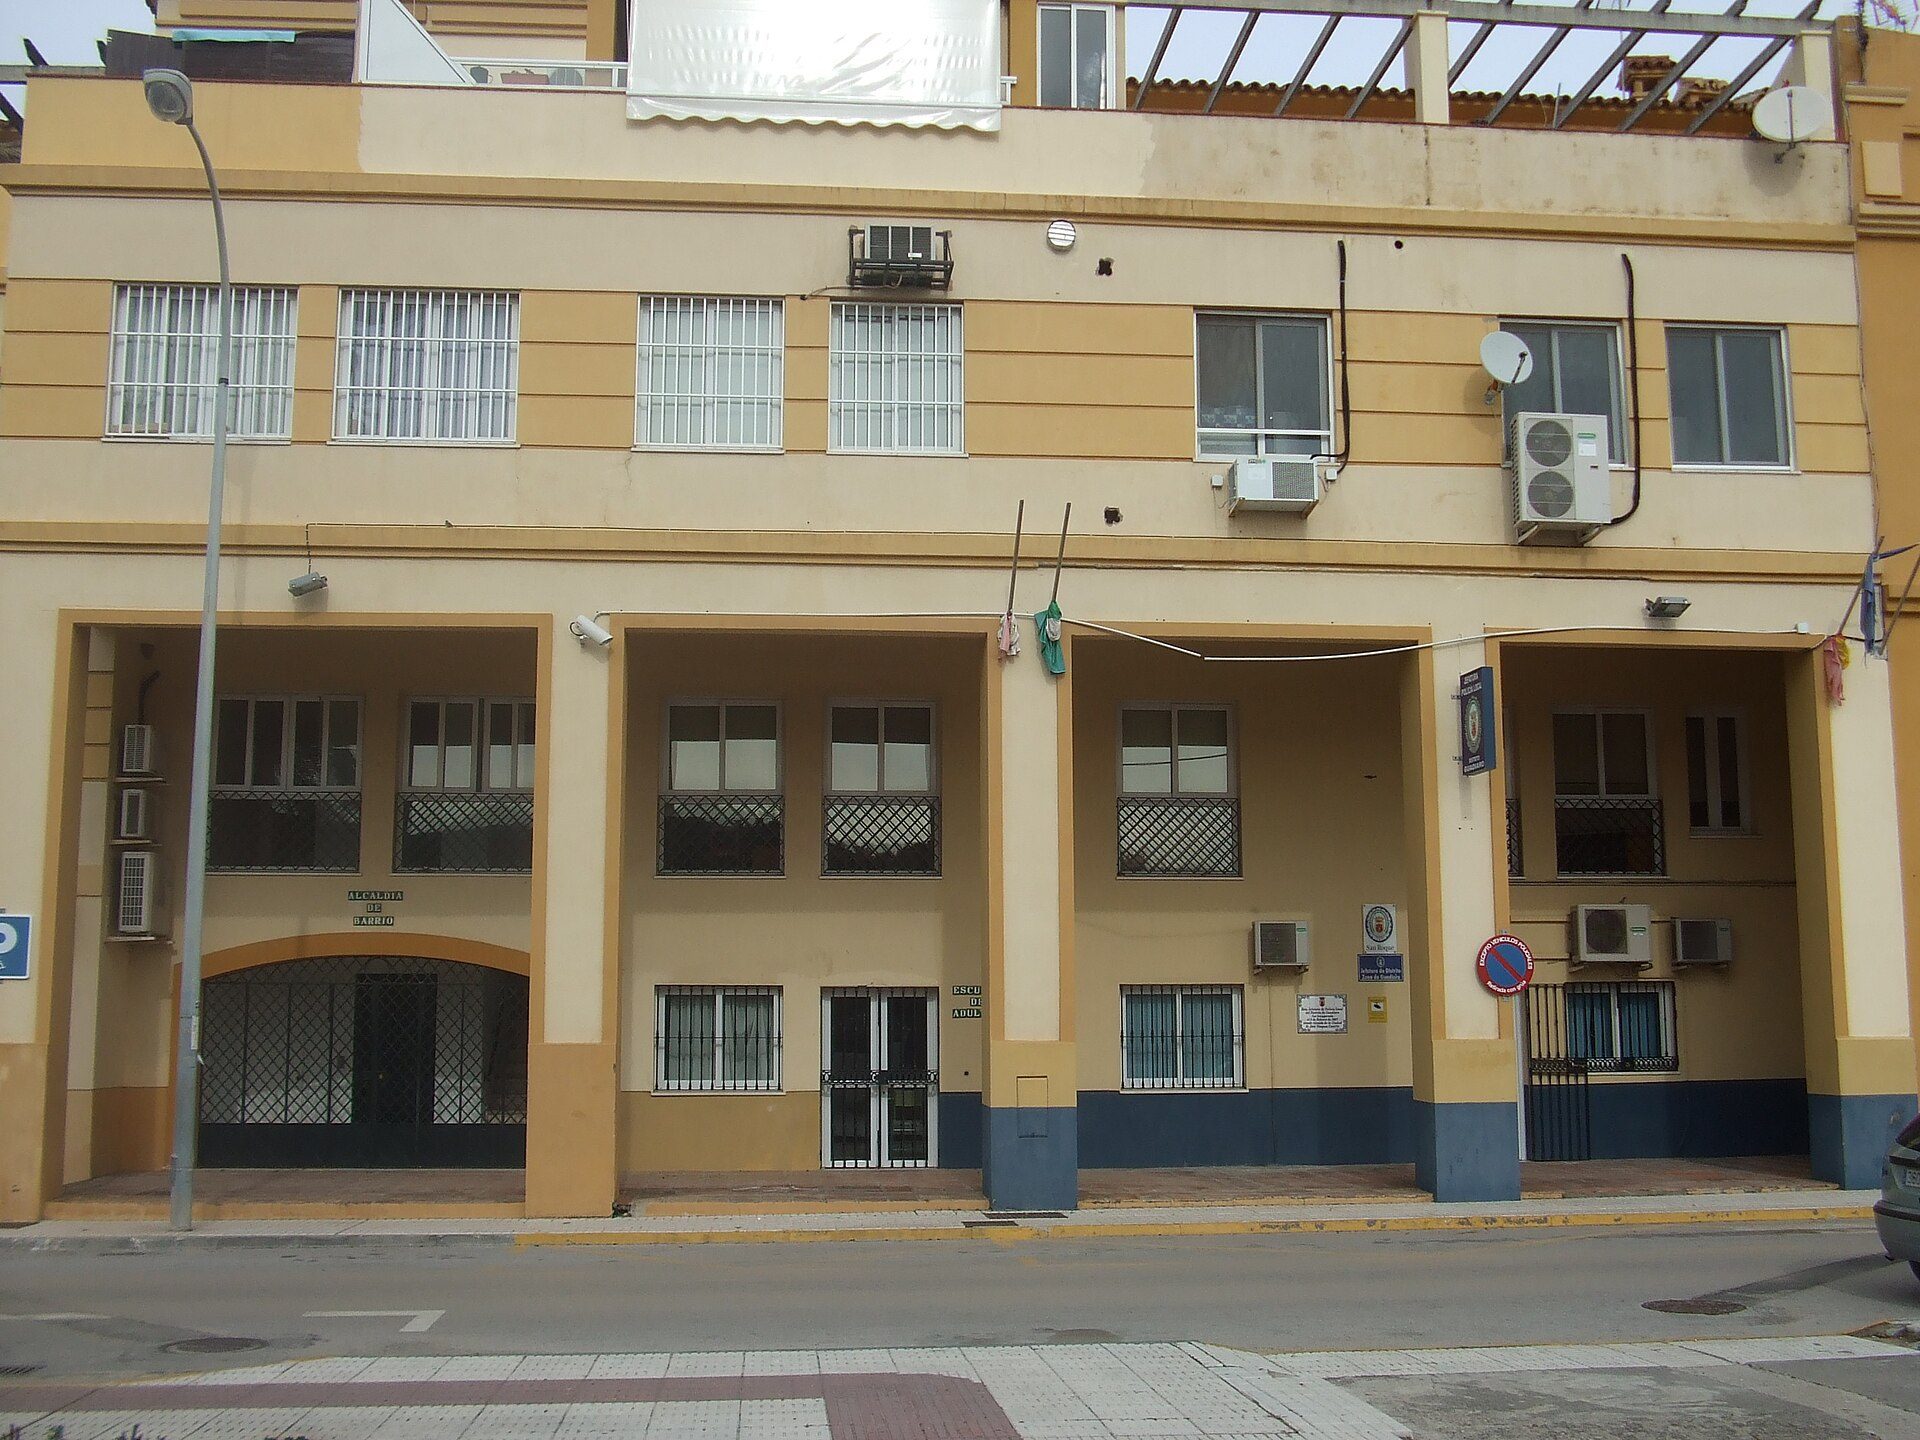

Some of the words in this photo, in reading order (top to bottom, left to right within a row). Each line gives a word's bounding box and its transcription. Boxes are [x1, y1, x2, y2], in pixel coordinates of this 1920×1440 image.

[348, 891, 402, 900] ALCALDIA
[367, 904, 381, 912] DE
[354, 917, 393, 925] BARRIO
